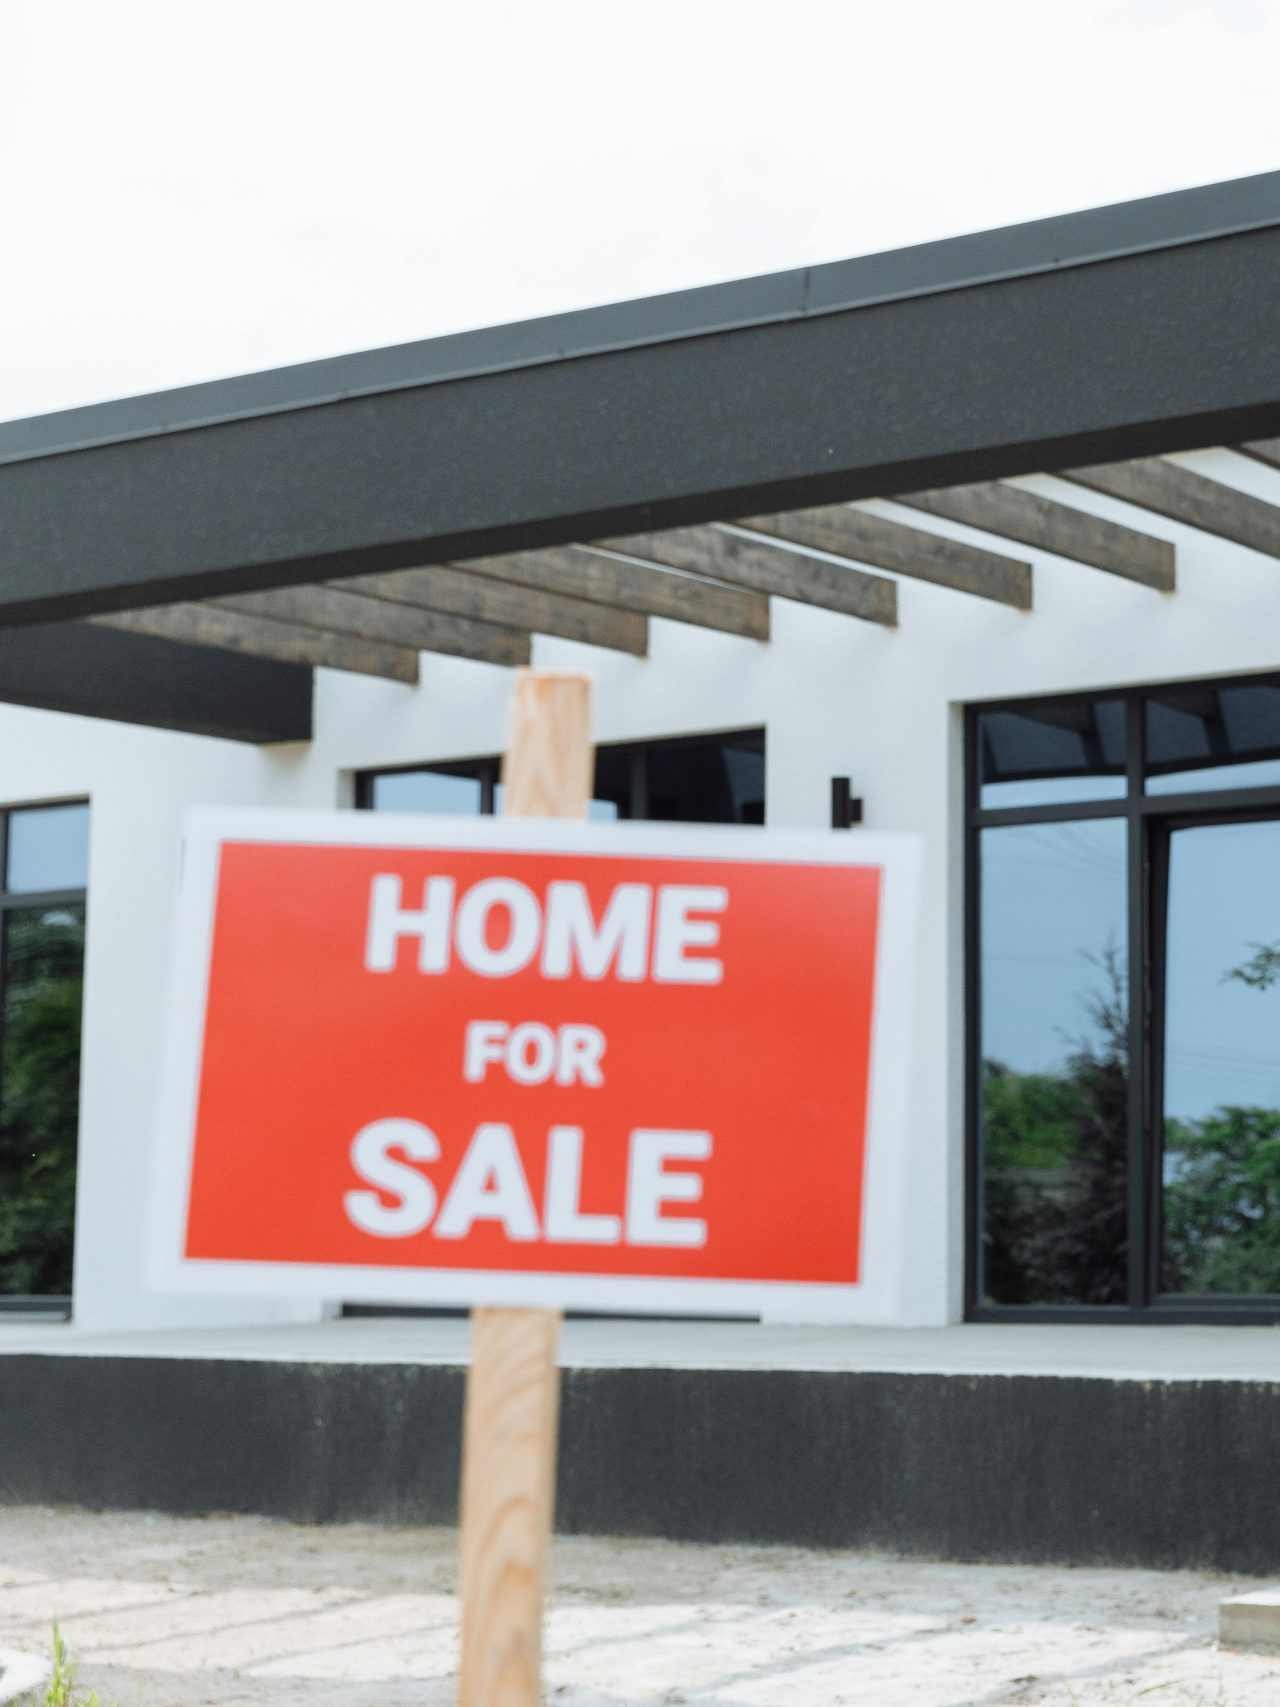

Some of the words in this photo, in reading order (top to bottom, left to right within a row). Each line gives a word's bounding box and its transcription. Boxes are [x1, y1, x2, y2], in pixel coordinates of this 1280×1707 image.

[365, 873, 729, 984] HOME
[464, 1020, 606, 1087] FOR
[344, 1117, 713, 1248] SALE
